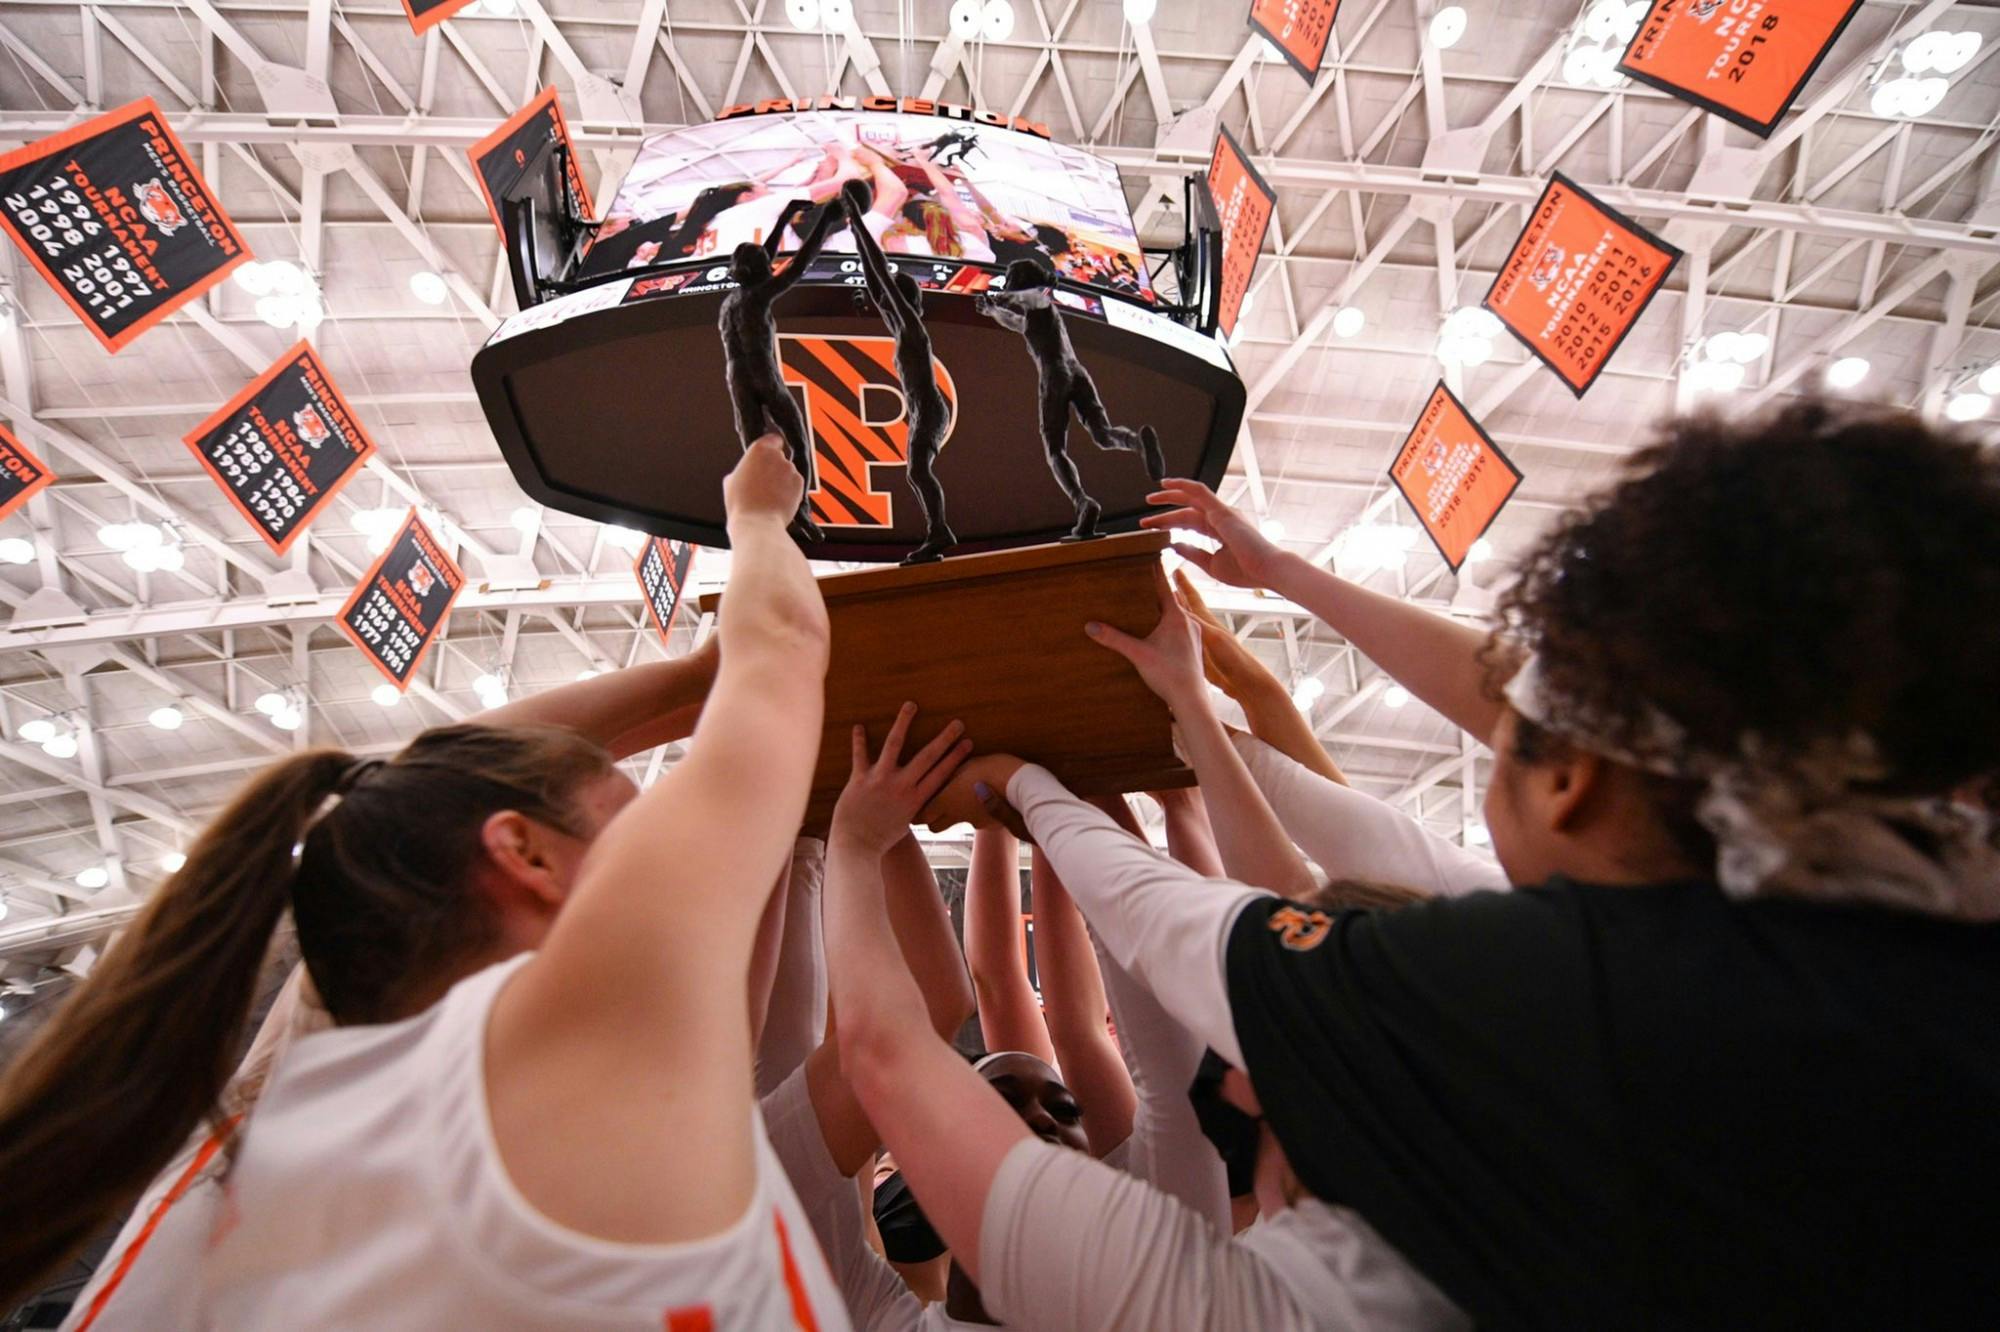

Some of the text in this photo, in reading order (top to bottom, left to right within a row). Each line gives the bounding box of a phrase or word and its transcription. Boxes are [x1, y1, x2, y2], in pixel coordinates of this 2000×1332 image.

[1706, 0, 1767, 81] TOURN
[1728, 15, 1780, 83] 2018
[715, 93, 1051, 140] PRINCETON
[65, 159, 169, 290] TOURNAMENT
[104, 186, 159, 256] NCAA
[140, 120, 238, 255] PRINCETON
[142, 142, 215, 247] MEN'S BASKETBALL
[4, 193, 117, 319] 2004 2011
[28, 185, 134, 308] 1998 2001
[50, 176, 152, 297] 1996 1997
[1495, 190, 1562, 304] PRINCETON
[1540, 230, 1615, 339] TOURNAMENT
[1546, 253, 1587, 308] NCAA
[1554, 247, 1623, 349] 2010 2011
[1564, 255, 1638, 359] 2012 2013
[1576, 265, 1652, 371] 2015 2016
[274, 420, 311, 469] NCAA
[297, 357, 366, 453] PRINCETON
[317, 402, 349, 449] BASKETBALL
[774, 336, 958, 529] P
[1397, 396, 1445, 477] PRINCETON
[212, 445, 284, 532] 1991 1992
[226, 434, 295, 518] 1989 1990
[238, 422, 306, 507] 1983 1984
[249, 406, 319, 496] TOURNAMENT
[1428, 443, 1481, 524] CHAMPIONS
[1439, 456, 1487, 529] 2018 2019
[409, 520, 460, 590] PRINCETON
[363, 602, 412, 661] 1969 1976
[371, 590, 421, 648] 1965 1967
[377, 575, 428, 636] TOURNAMENT
[394, 579, 422, 616] NCAA
[354, 615, 405, 673] 1977 1981
